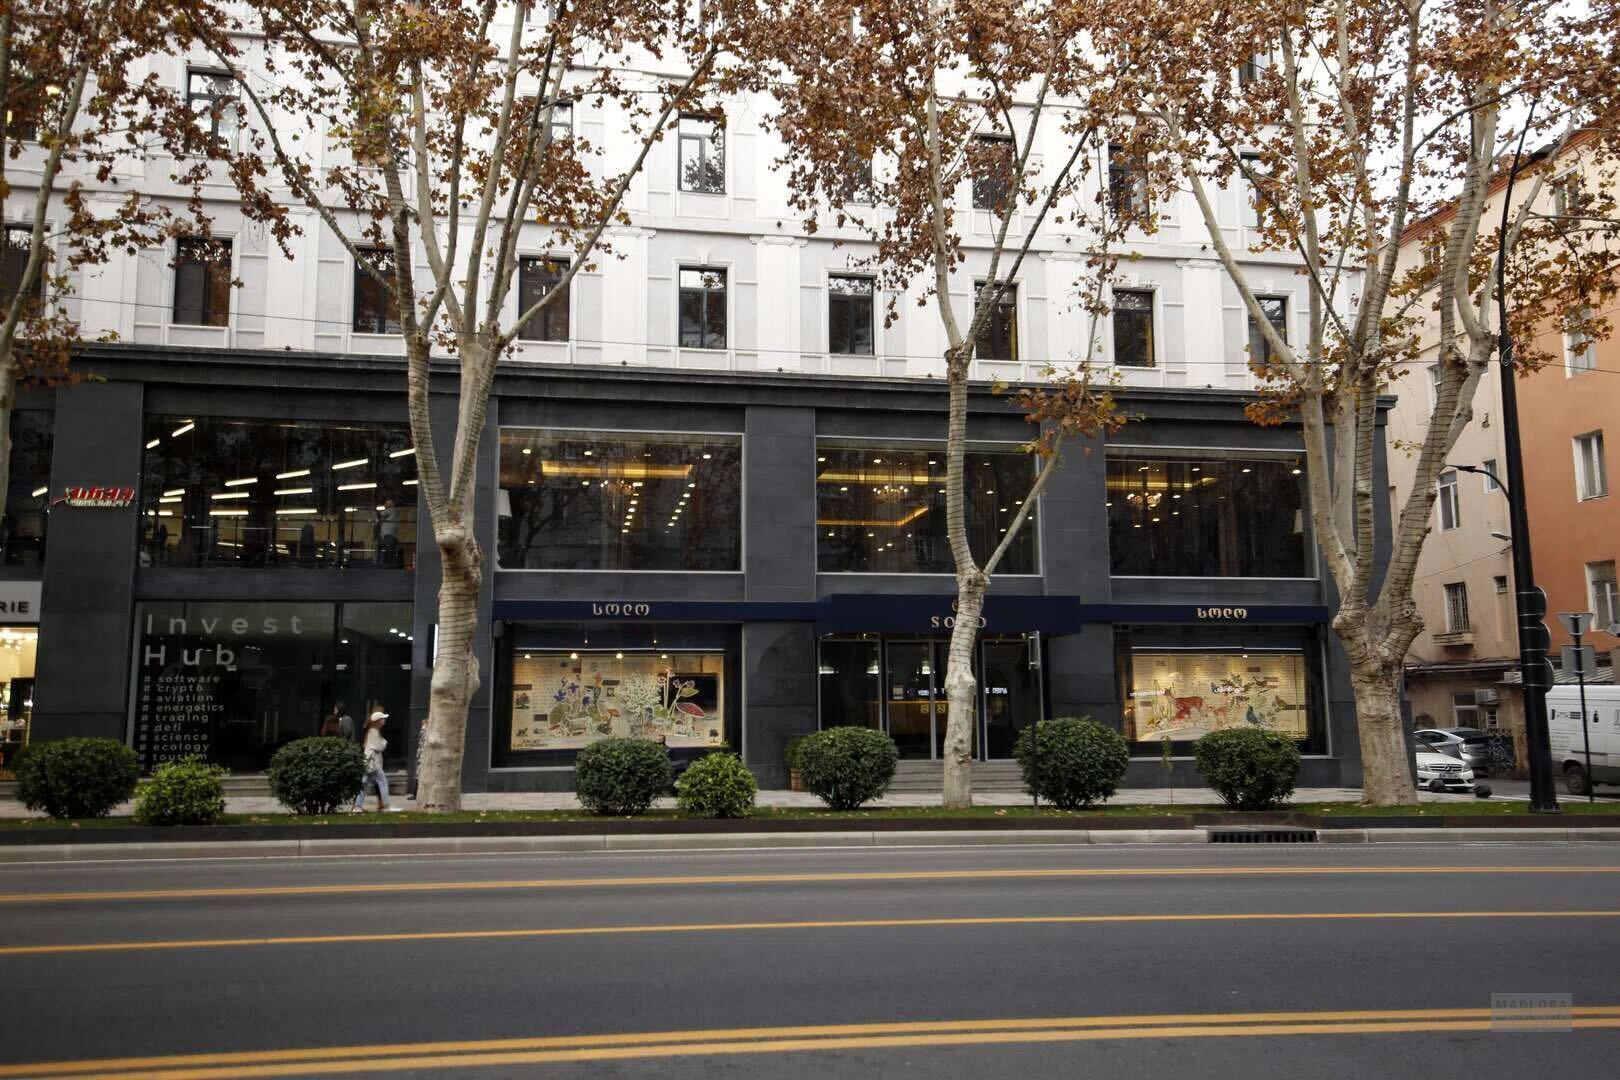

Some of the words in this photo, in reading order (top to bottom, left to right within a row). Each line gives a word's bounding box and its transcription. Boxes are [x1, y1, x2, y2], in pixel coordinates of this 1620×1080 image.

[147, 614, 302, 635] Invest
[931, 616, 987, 629] SOO
[144, 644, 235, 666] Hub
[158, 674, 220, 683] software
[157, 694, 214, 702] aviation
[155, 713, 209, 723] trading
[154, 723, 181, 732] defi
[154, 733, 208, 742] science
[153, 743, 210, 752] ecology
